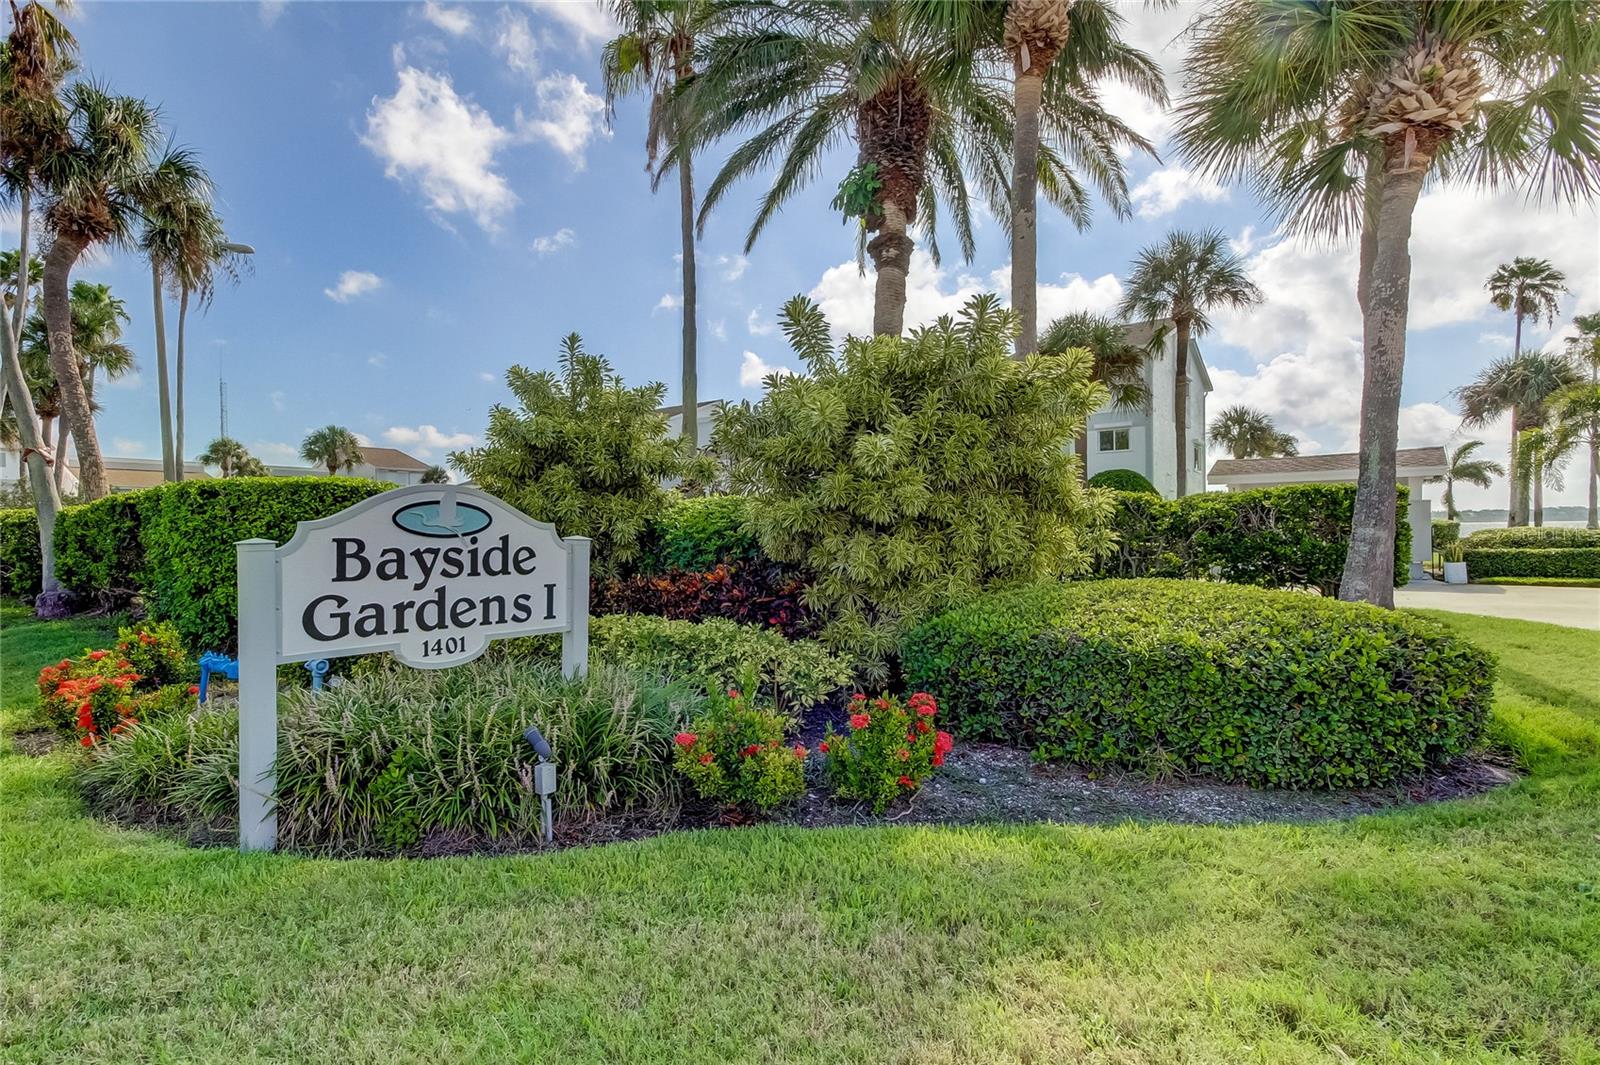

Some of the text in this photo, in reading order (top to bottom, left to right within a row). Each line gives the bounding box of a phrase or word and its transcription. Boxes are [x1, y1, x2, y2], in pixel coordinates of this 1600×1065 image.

[332, 534, 537, 591] Bayside
[302, 583, 557, 642] Gardens I
[422, 636, 466, 658] 1401
